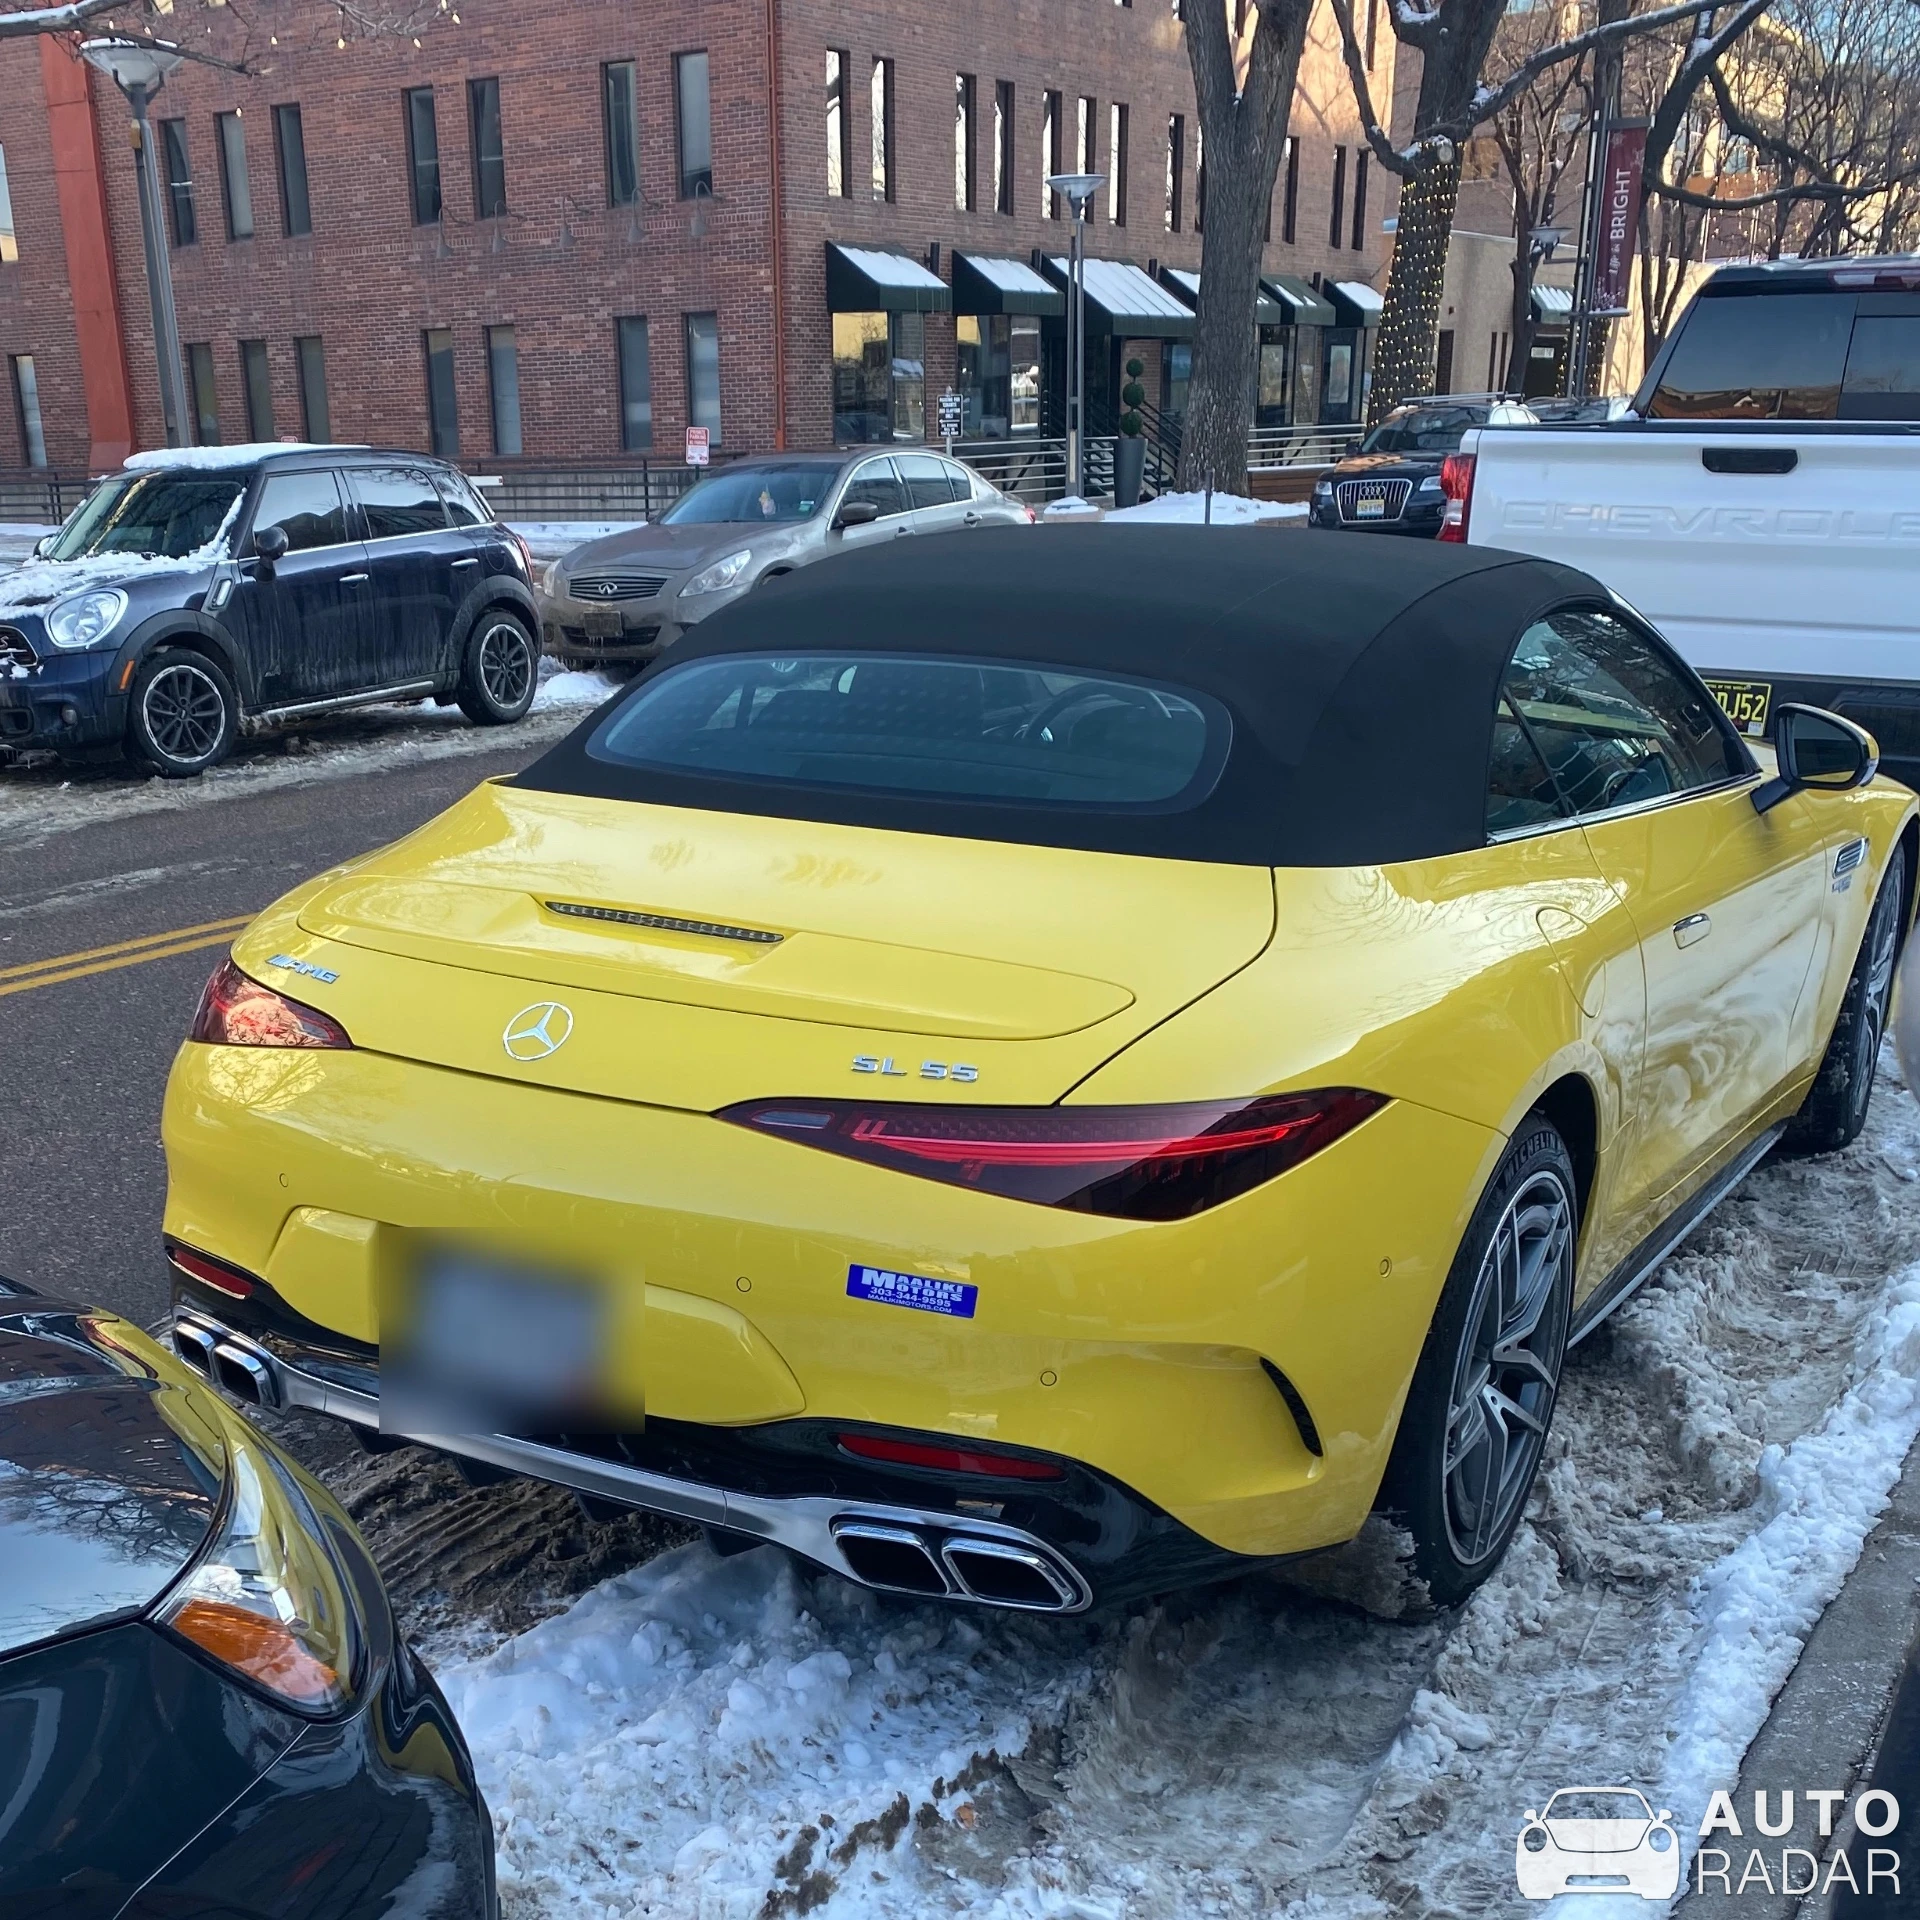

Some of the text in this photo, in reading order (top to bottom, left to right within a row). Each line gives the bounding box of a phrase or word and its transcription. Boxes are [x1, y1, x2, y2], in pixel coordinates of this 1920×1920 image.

[1610, 168, 1632, 240] BRIGHT
[1503, 501, 1920, 541] CHEVROLE
[1711, 691, 1766, 721] DJ52
[284, 959, 340, 984] AMG
[851, 1054, 979, 1083] SL 55
[1504, 1132, 1556, 1187] MICHELIN
[861, 1268, 963, 1292] MAALIKI
[867, 1294, 952, 1314] MAALIKIMOTORS.COM
[870, 1286, 951, 1308] 303-344-9595
